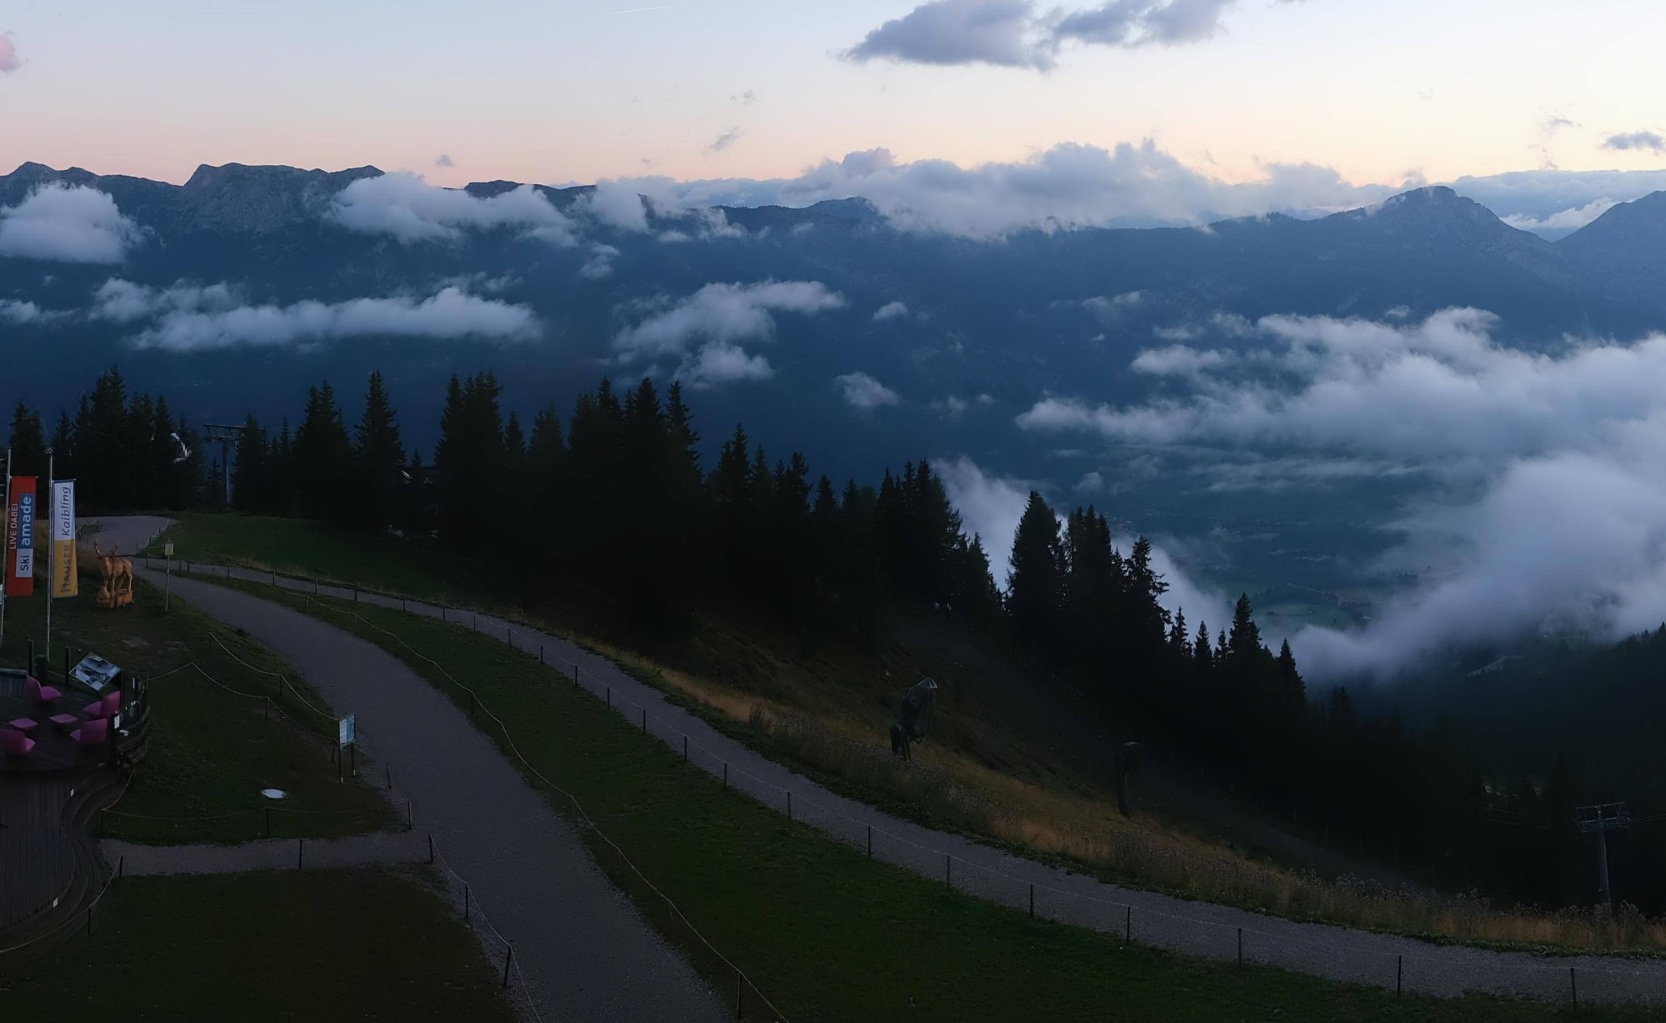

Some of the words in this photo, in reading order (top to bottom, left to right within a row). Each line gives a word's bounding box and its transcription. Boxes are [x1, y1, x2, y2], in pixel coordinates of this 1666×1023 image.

[10, 503, 18, 527] DABEI
[61, 487, 71, 536] Kaibling
[8, 530, 17, 550] LIVE
[20, 555, 30, 571] Ski
[61, 544, 71, 593] HAUSER
